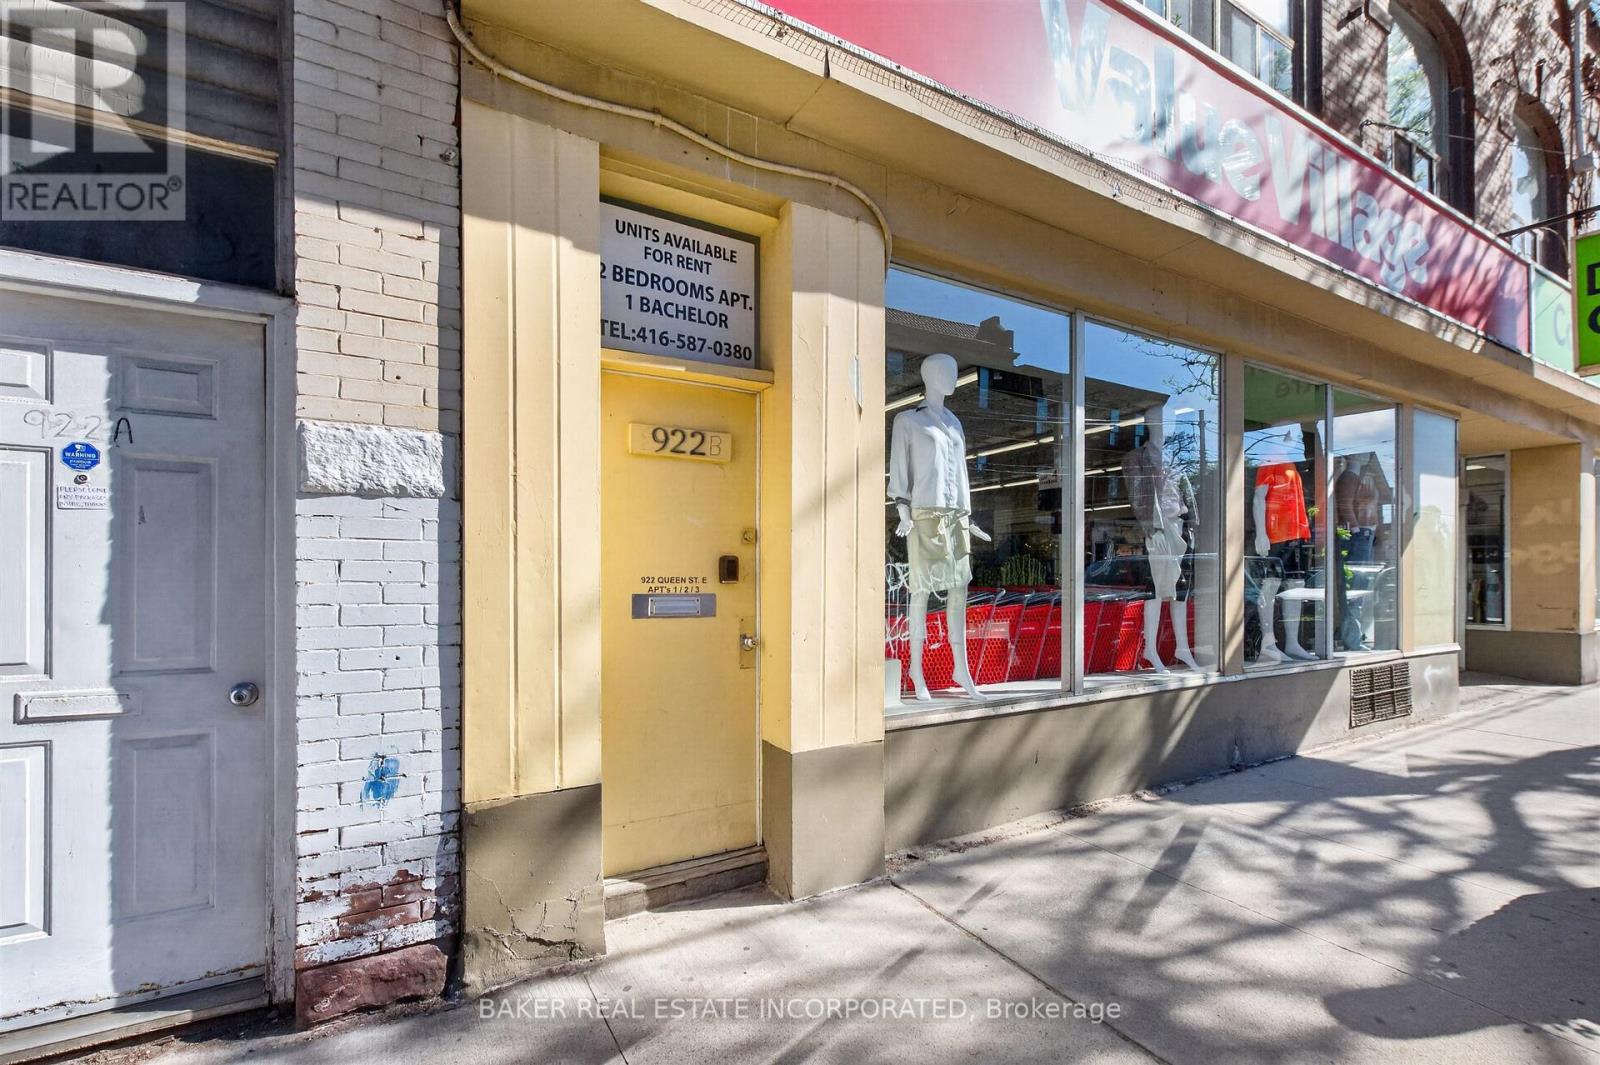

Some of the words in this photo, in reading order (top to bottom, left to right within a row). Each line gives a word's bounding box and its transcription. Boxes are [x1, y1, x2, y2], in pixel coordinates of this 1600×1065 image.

[1040, 0, 1266, 201] Value
[1264, 112, 1429, 293] Village
[615, 218, 660, 243] UNITS
[663, 232, 737, 262] AVAILABLE
[644, 246, 672, 265] FOR
[676, 254, 712, 274] RENT
[600, 261, 606, 279] 2
[612, 265, 714, 301] BEDROOMS
[718, 289, 753, 312] APT.
[625, 294, 633, 310] 1
[640, 296, 728, 328] BACHELOR
[600, 319, 752, 360] TEL:416-587-0380
[23, 409, 103, 441] 922
[113, 417, 134, 445] A
[641, 576, 656, 584] 922
[657, 576, 687, 584] QUEEN
[688, 576, 700, 584] ST.
[702, 576, 708, 584] E
